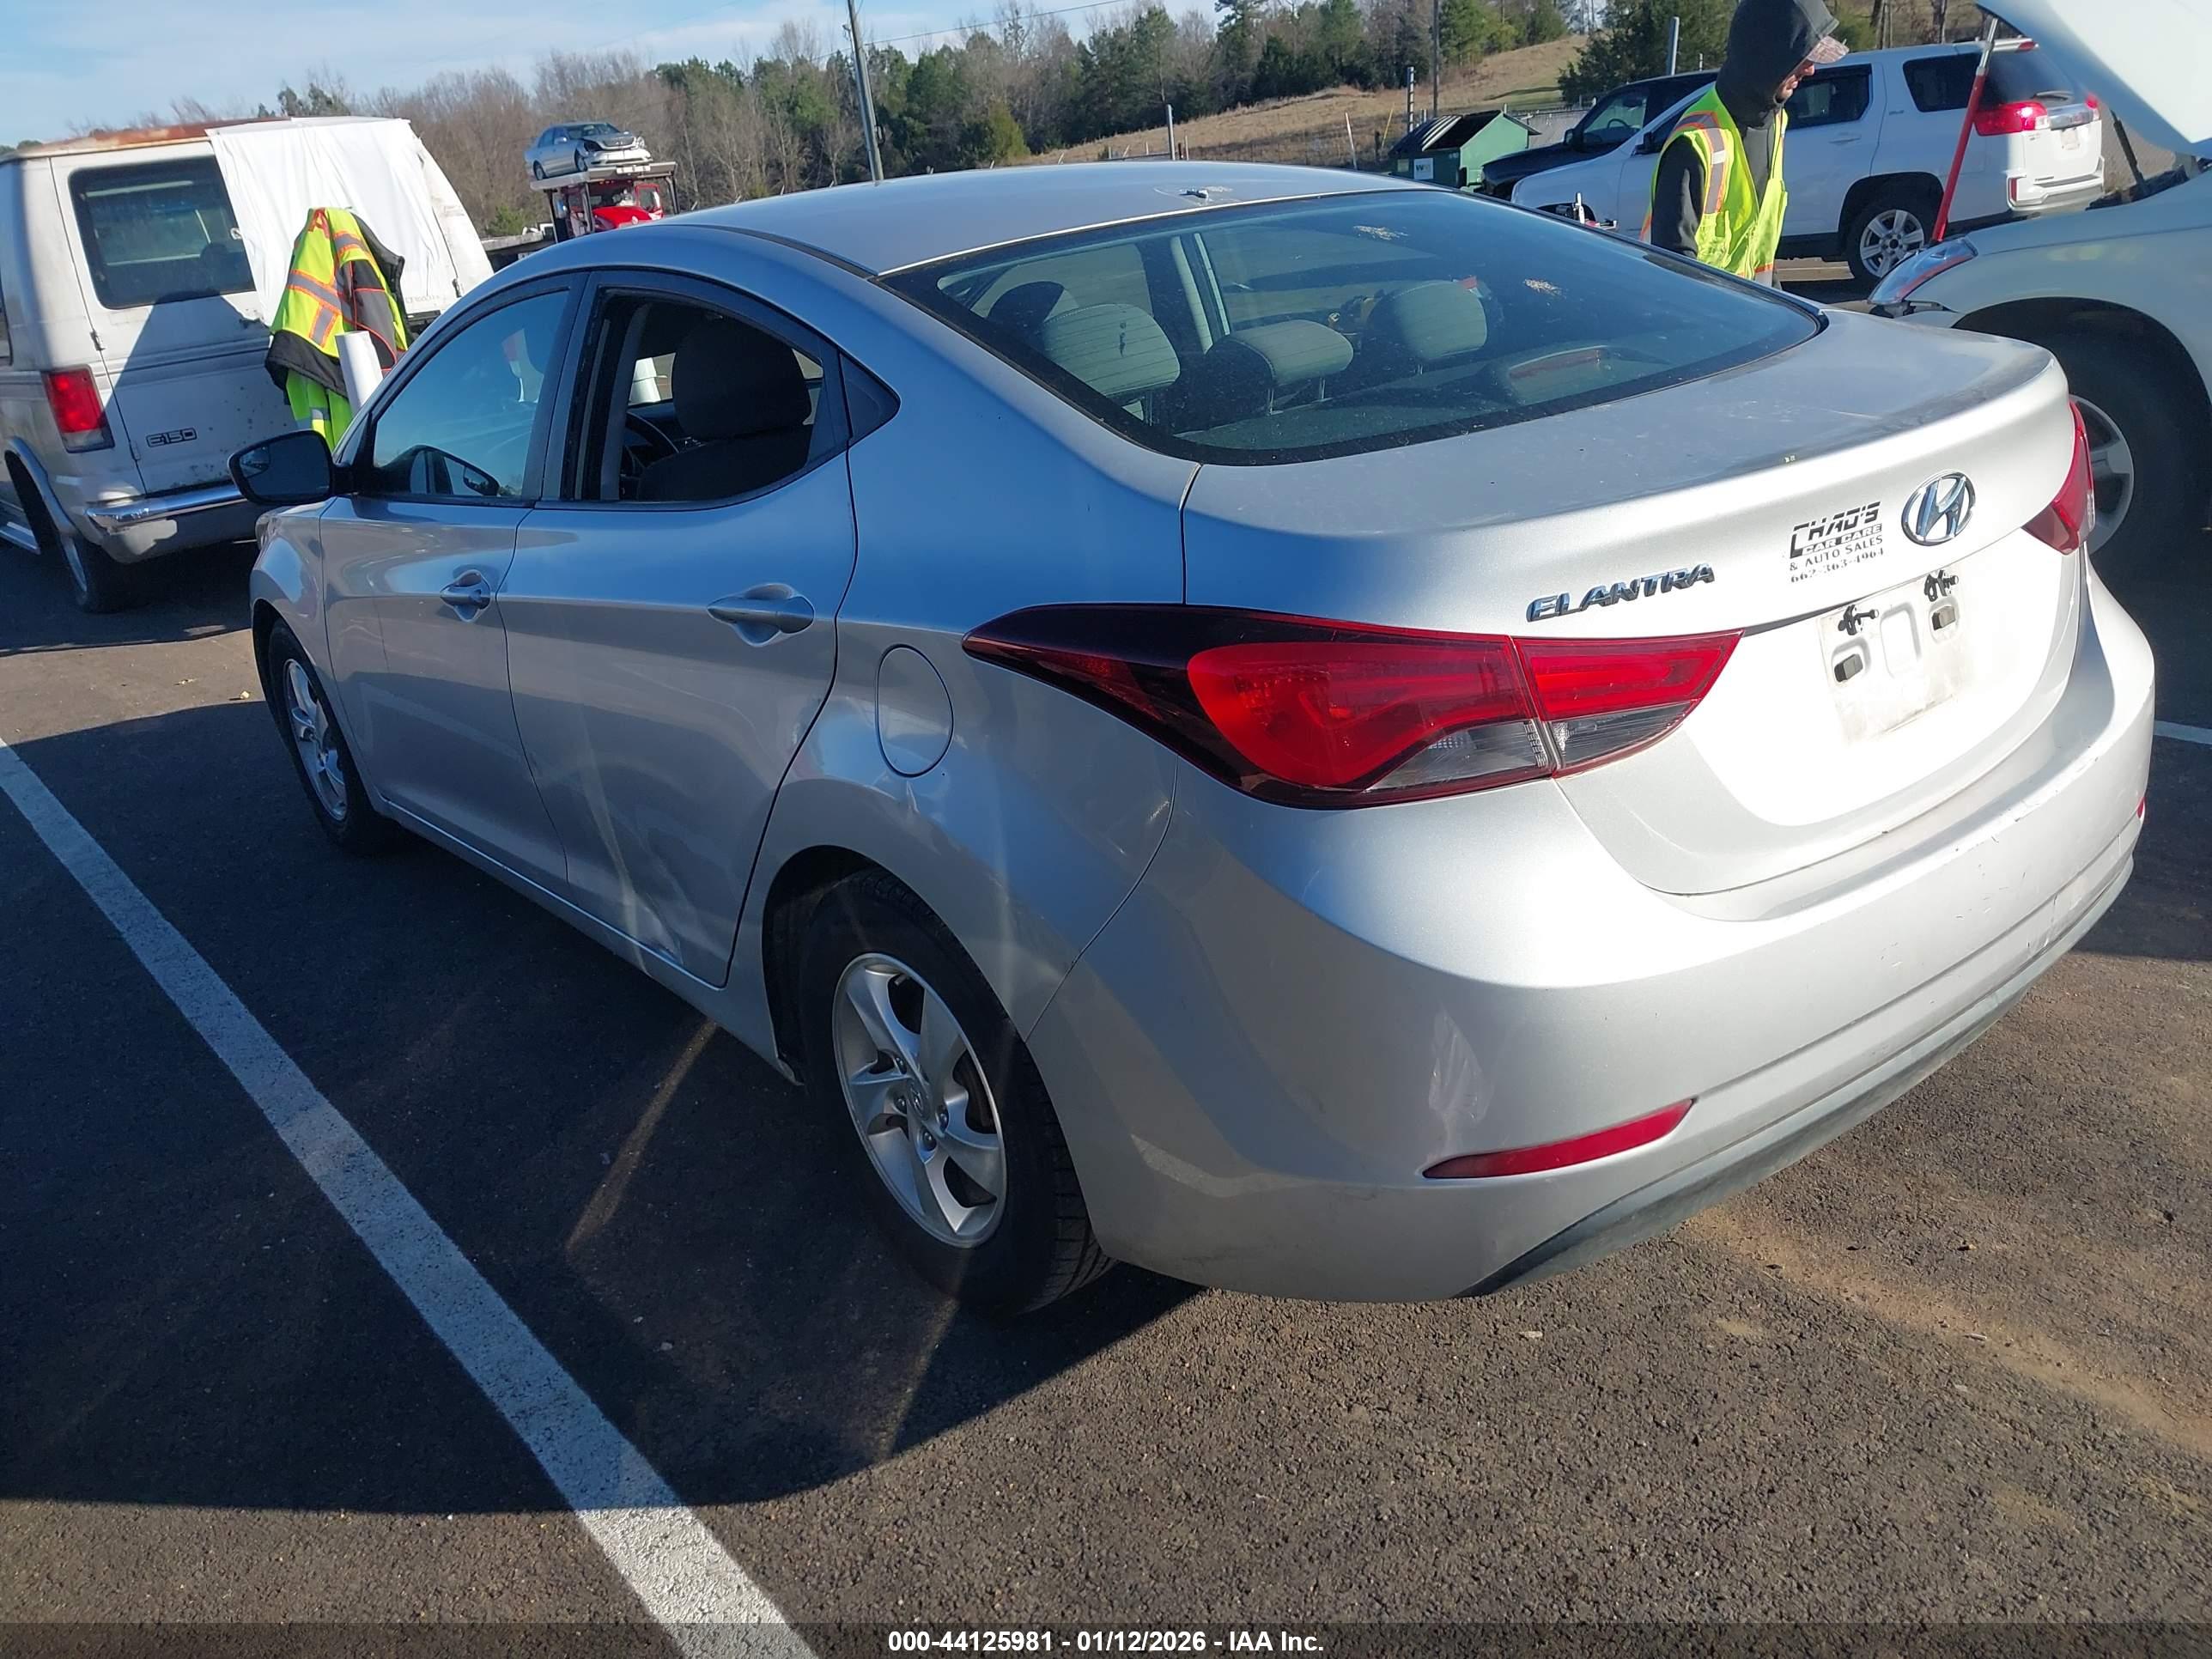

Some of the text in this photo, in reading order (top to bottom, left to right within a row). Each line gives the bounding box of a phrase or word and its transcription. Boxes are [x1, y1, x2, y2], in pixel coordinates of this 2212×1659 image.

[1790, 534, 1883, 571] & AUTO SALES
[1802, 524, 1882, 556] CAR CARE
[1526, 562, 1716, 623] ELANTRA
